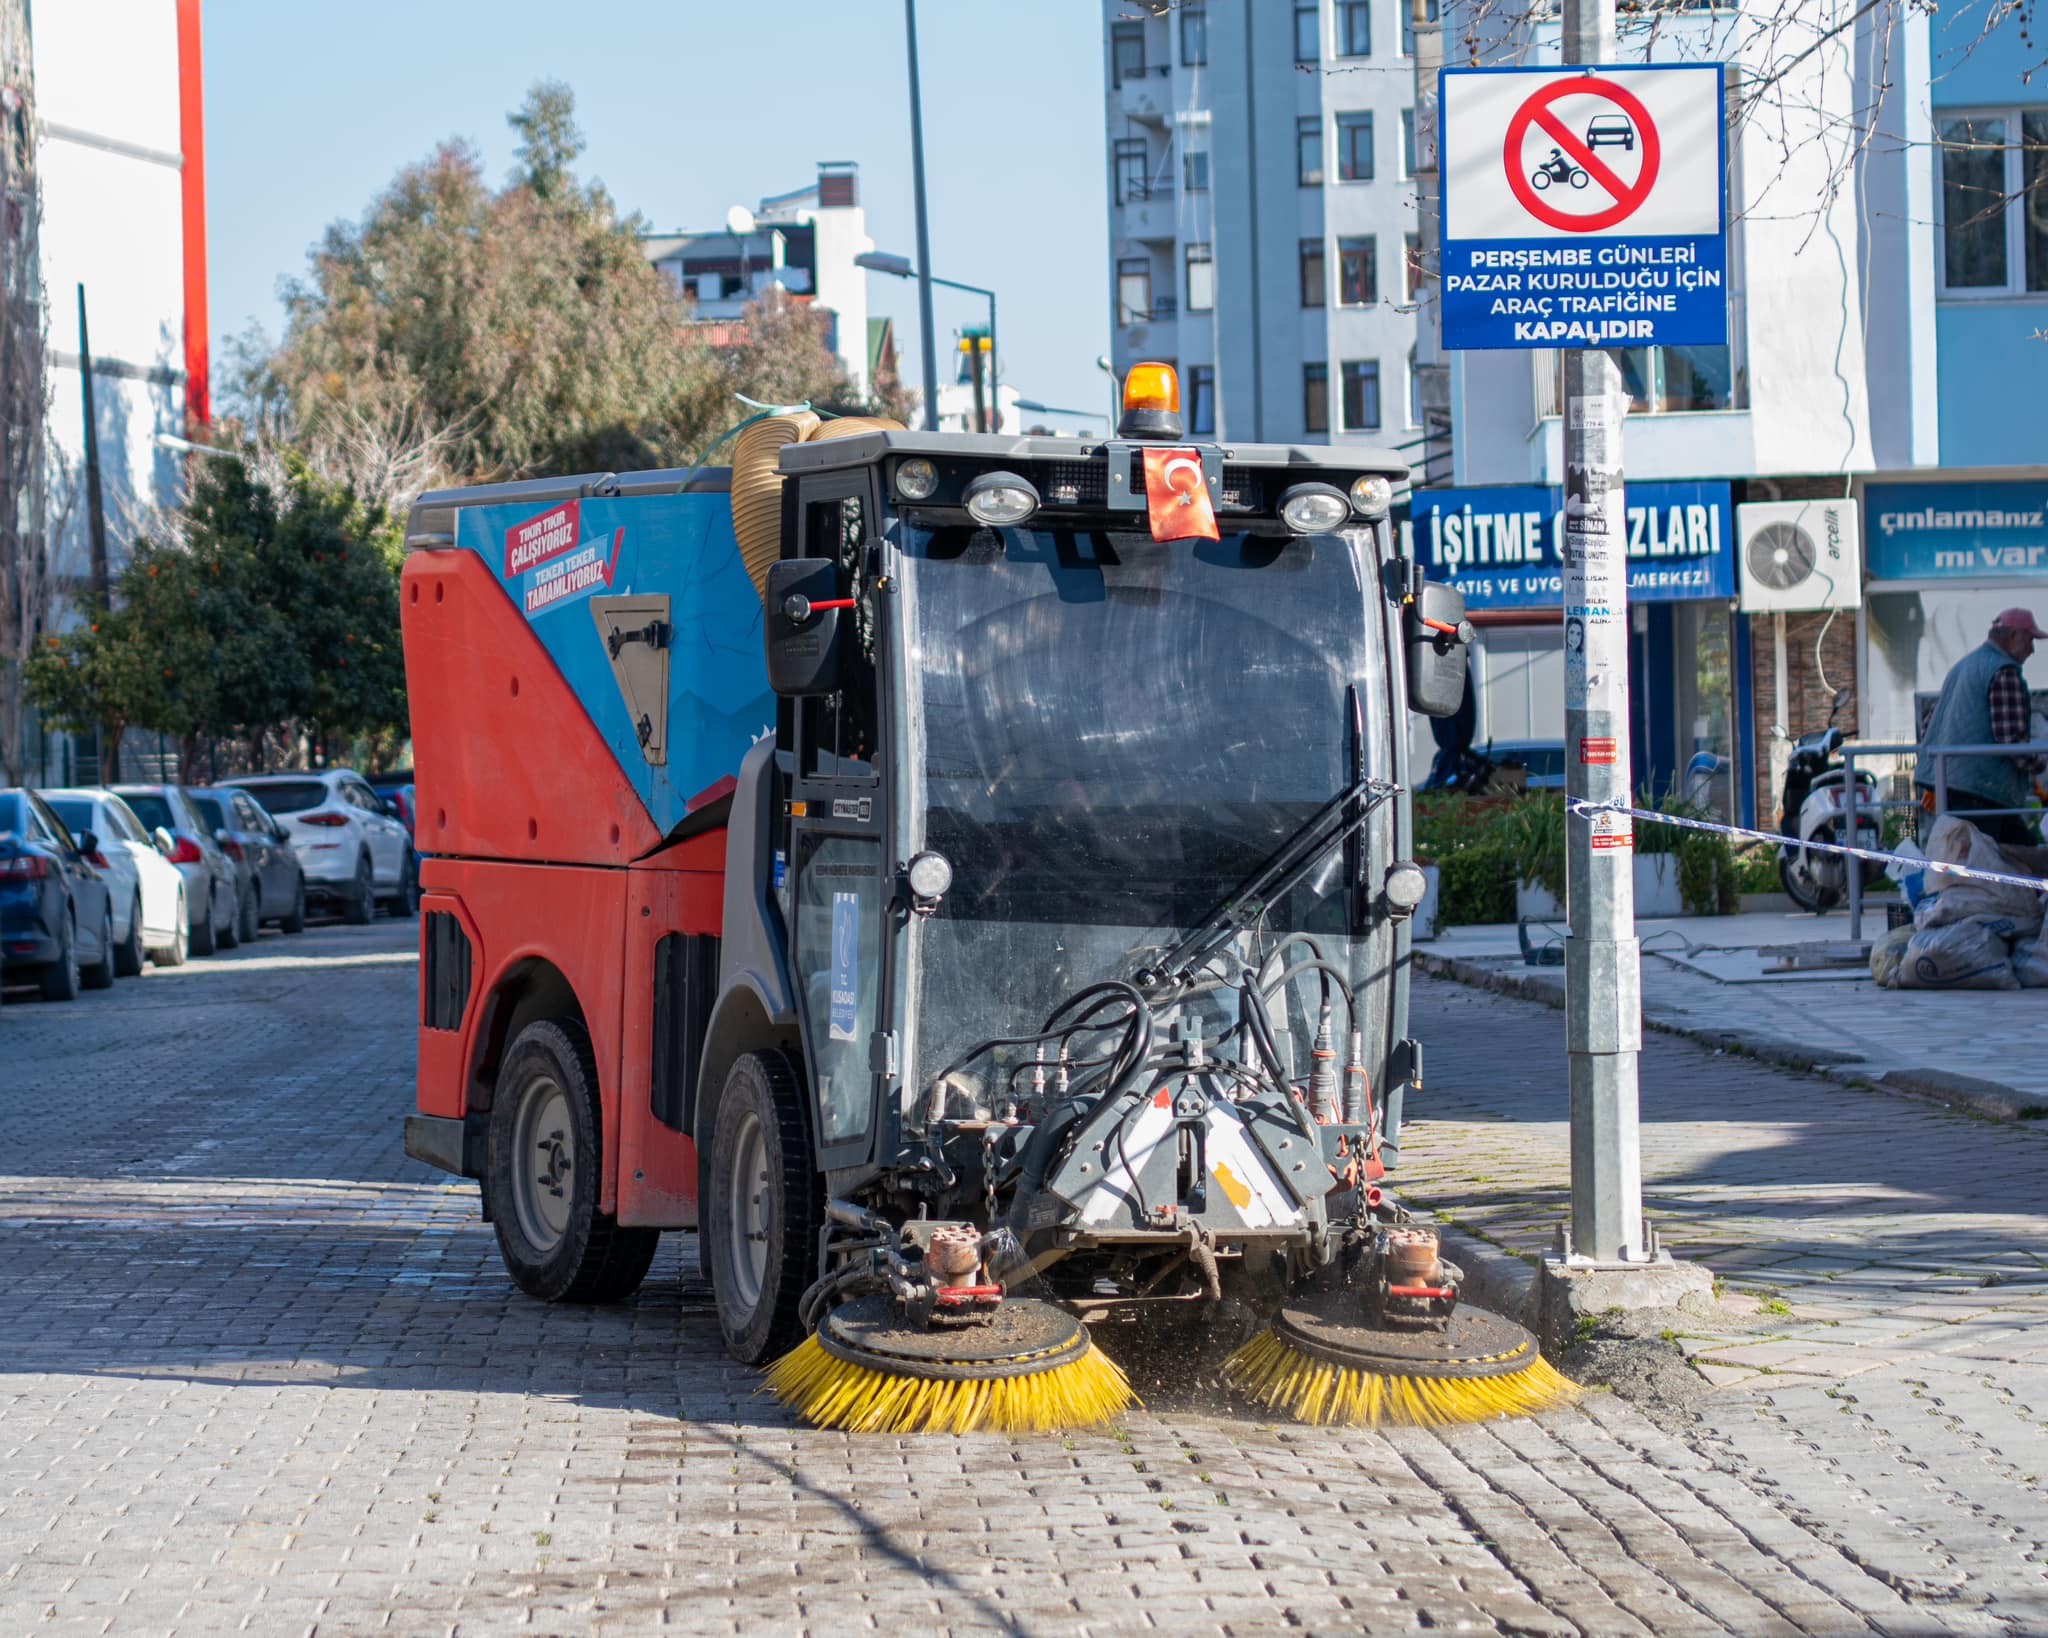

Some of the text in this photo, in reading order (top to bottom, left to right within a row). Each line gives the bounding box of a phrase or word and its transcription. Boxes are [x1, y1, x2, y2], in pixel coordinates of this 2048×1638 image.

[1471, 242, 1696, 271] PERŞEMBE GÜNLERİ
[1447, 265, 1720, 292] PAZAR KURULDUĞU İÇİN
[1490, 290, 1677, 318] ARAÇ TRAFİĞİNE
[1514, 319, 1654, 341] KAPALIDIR
[519, 510, 566, 544] TIKIR TIKIR
[1880, 506, 2044, 536] çınlamanız
[511, 522, 573, 574] ÇALIŞIYORUZ
[1431, 503, 1543, 577] İŞİTME
[535, 547, 596, 586] TEKER TEKER
[1934, 546, 2045, 568] mı var
[527, 559, 604, 611] TAMAMLIYORUZ
[1445, 579, 1493, 598] ATIŞ
[1497, 577, 1519, 594] VE
